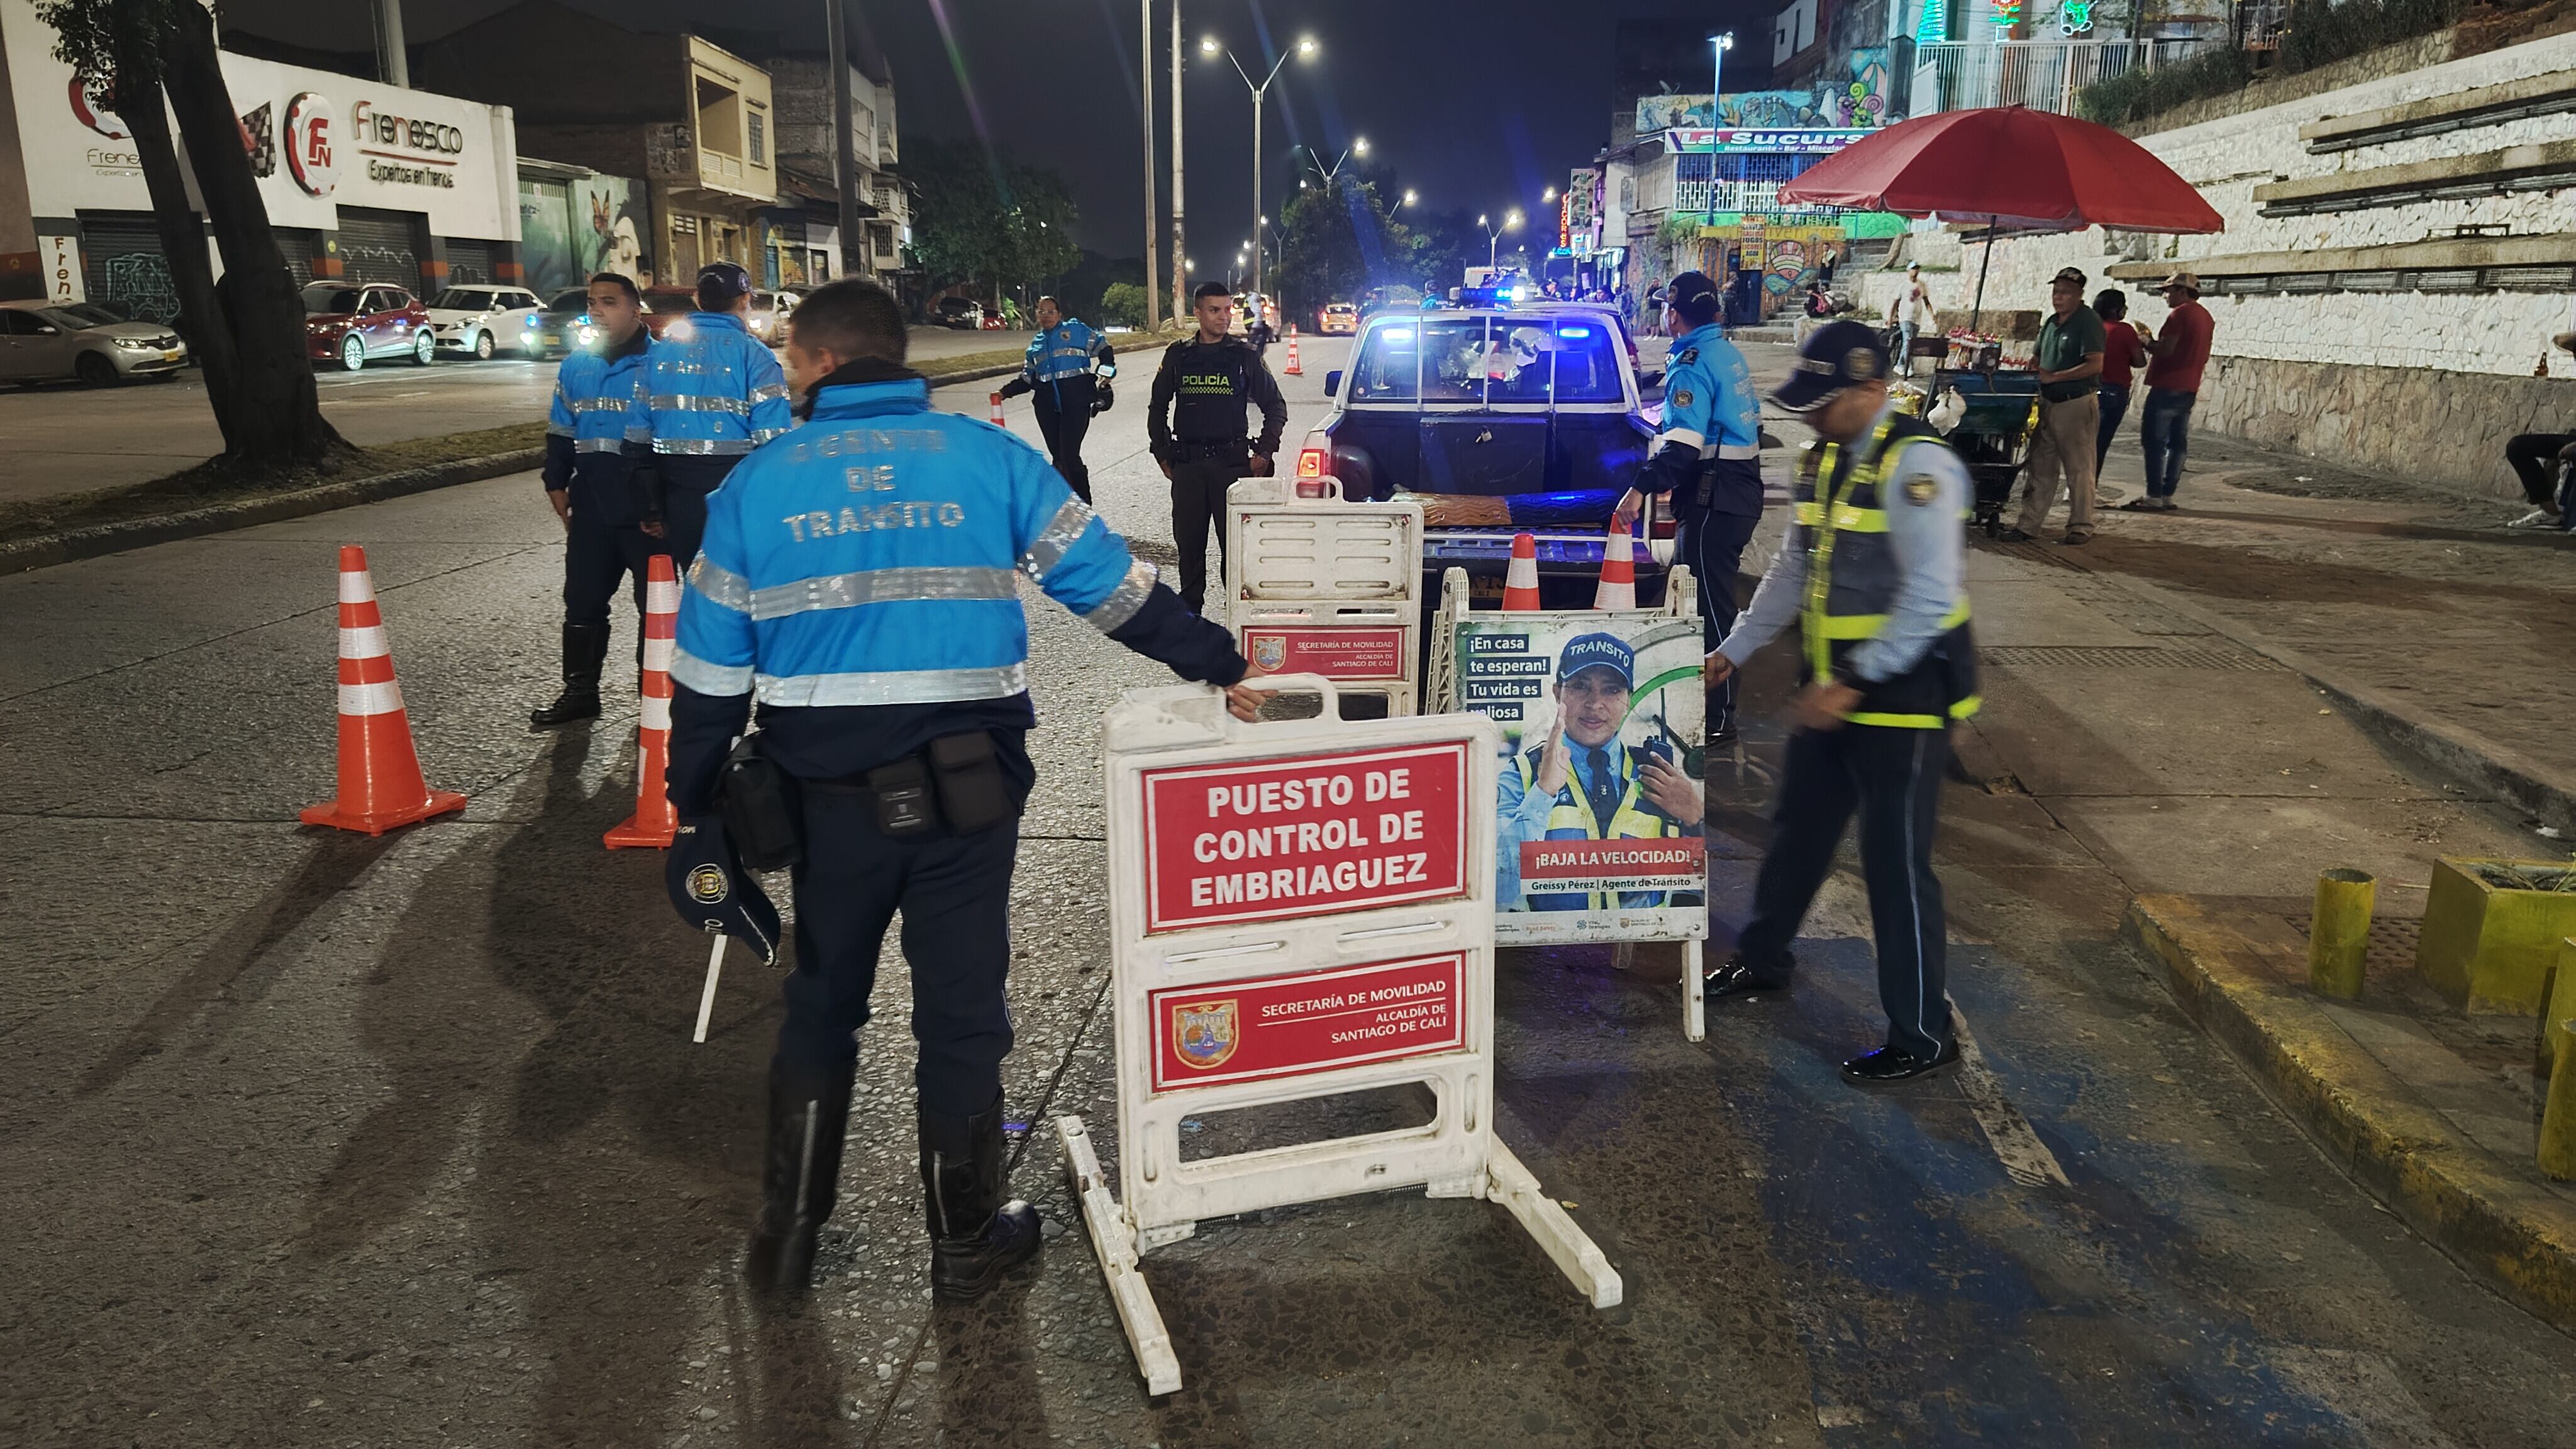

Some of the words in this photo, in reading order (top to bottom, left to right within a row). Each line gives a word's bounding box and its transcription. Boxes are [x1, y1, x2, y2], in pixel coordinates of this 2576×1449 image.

[1680, 132, 1721, 145] La
[96, 169, 130, 177] Experto
[369, 159, 412, 185] Expertos
[413, 170, 425, 185] en
[55, 238, 72, 301] Fren
[1182, 373, 1230, 386] POLICÍA
[845, 464, 896, 493] DE
[782, 501, 965, 543] TRANSITO
[1297, 640, 1340, 649] SECRETARÍA
[1470, 637, 1492, 653] ¡En
[1494, 639, 1524, 649] casa
[1570, 640, 1630, 667] TRANSITO
[1470, 661, 1484, 672] te
[1487, 658, 1546, 675] esperan!
[1470, 683, 1487, 696] Tu
[1490, 682, 1520, 696] vida
[1523, 685, 1538, 695] es
[1207, 774, 1354, 818] PUESTO
[1365, 769, 1410, 802] DE
[1193, 818, 1368, 863] CONTROL
[1379, 810, 1424, 845] DE
[1535, 853, 1577, 870] ¡BAJA
[1580, 852, 1600, 865] LA
[1601, 850, 1690, 865] VELOCIDAD!
[1191, 852, 1428, 908] EMBRIAGUEZ
[1531, 881, 1566, 891] Greissy
[1568, 880, 1595, 889] Pérez
[1601, 879, 1636, 890] Agente
[1638, 879, 1650, 887] de
[1651, 877, 1691, 886] Tránsito
[1261, 994, 1345, 1018] SECRETARÍA
[1348, 992, 1367, 1005] DE
[1370, 980, 1446, 1002] MOVILIDAD
[1375, 1004, 1428, 1023] ALCALDÍA
[1431, 1004, 1446, 1014] DE
[1331, 1023, 1396, 1044] SANTIAGO
[1399, 1021, 1416, 1033] DE
[1419, 1016, 1446, 1030] CALI
